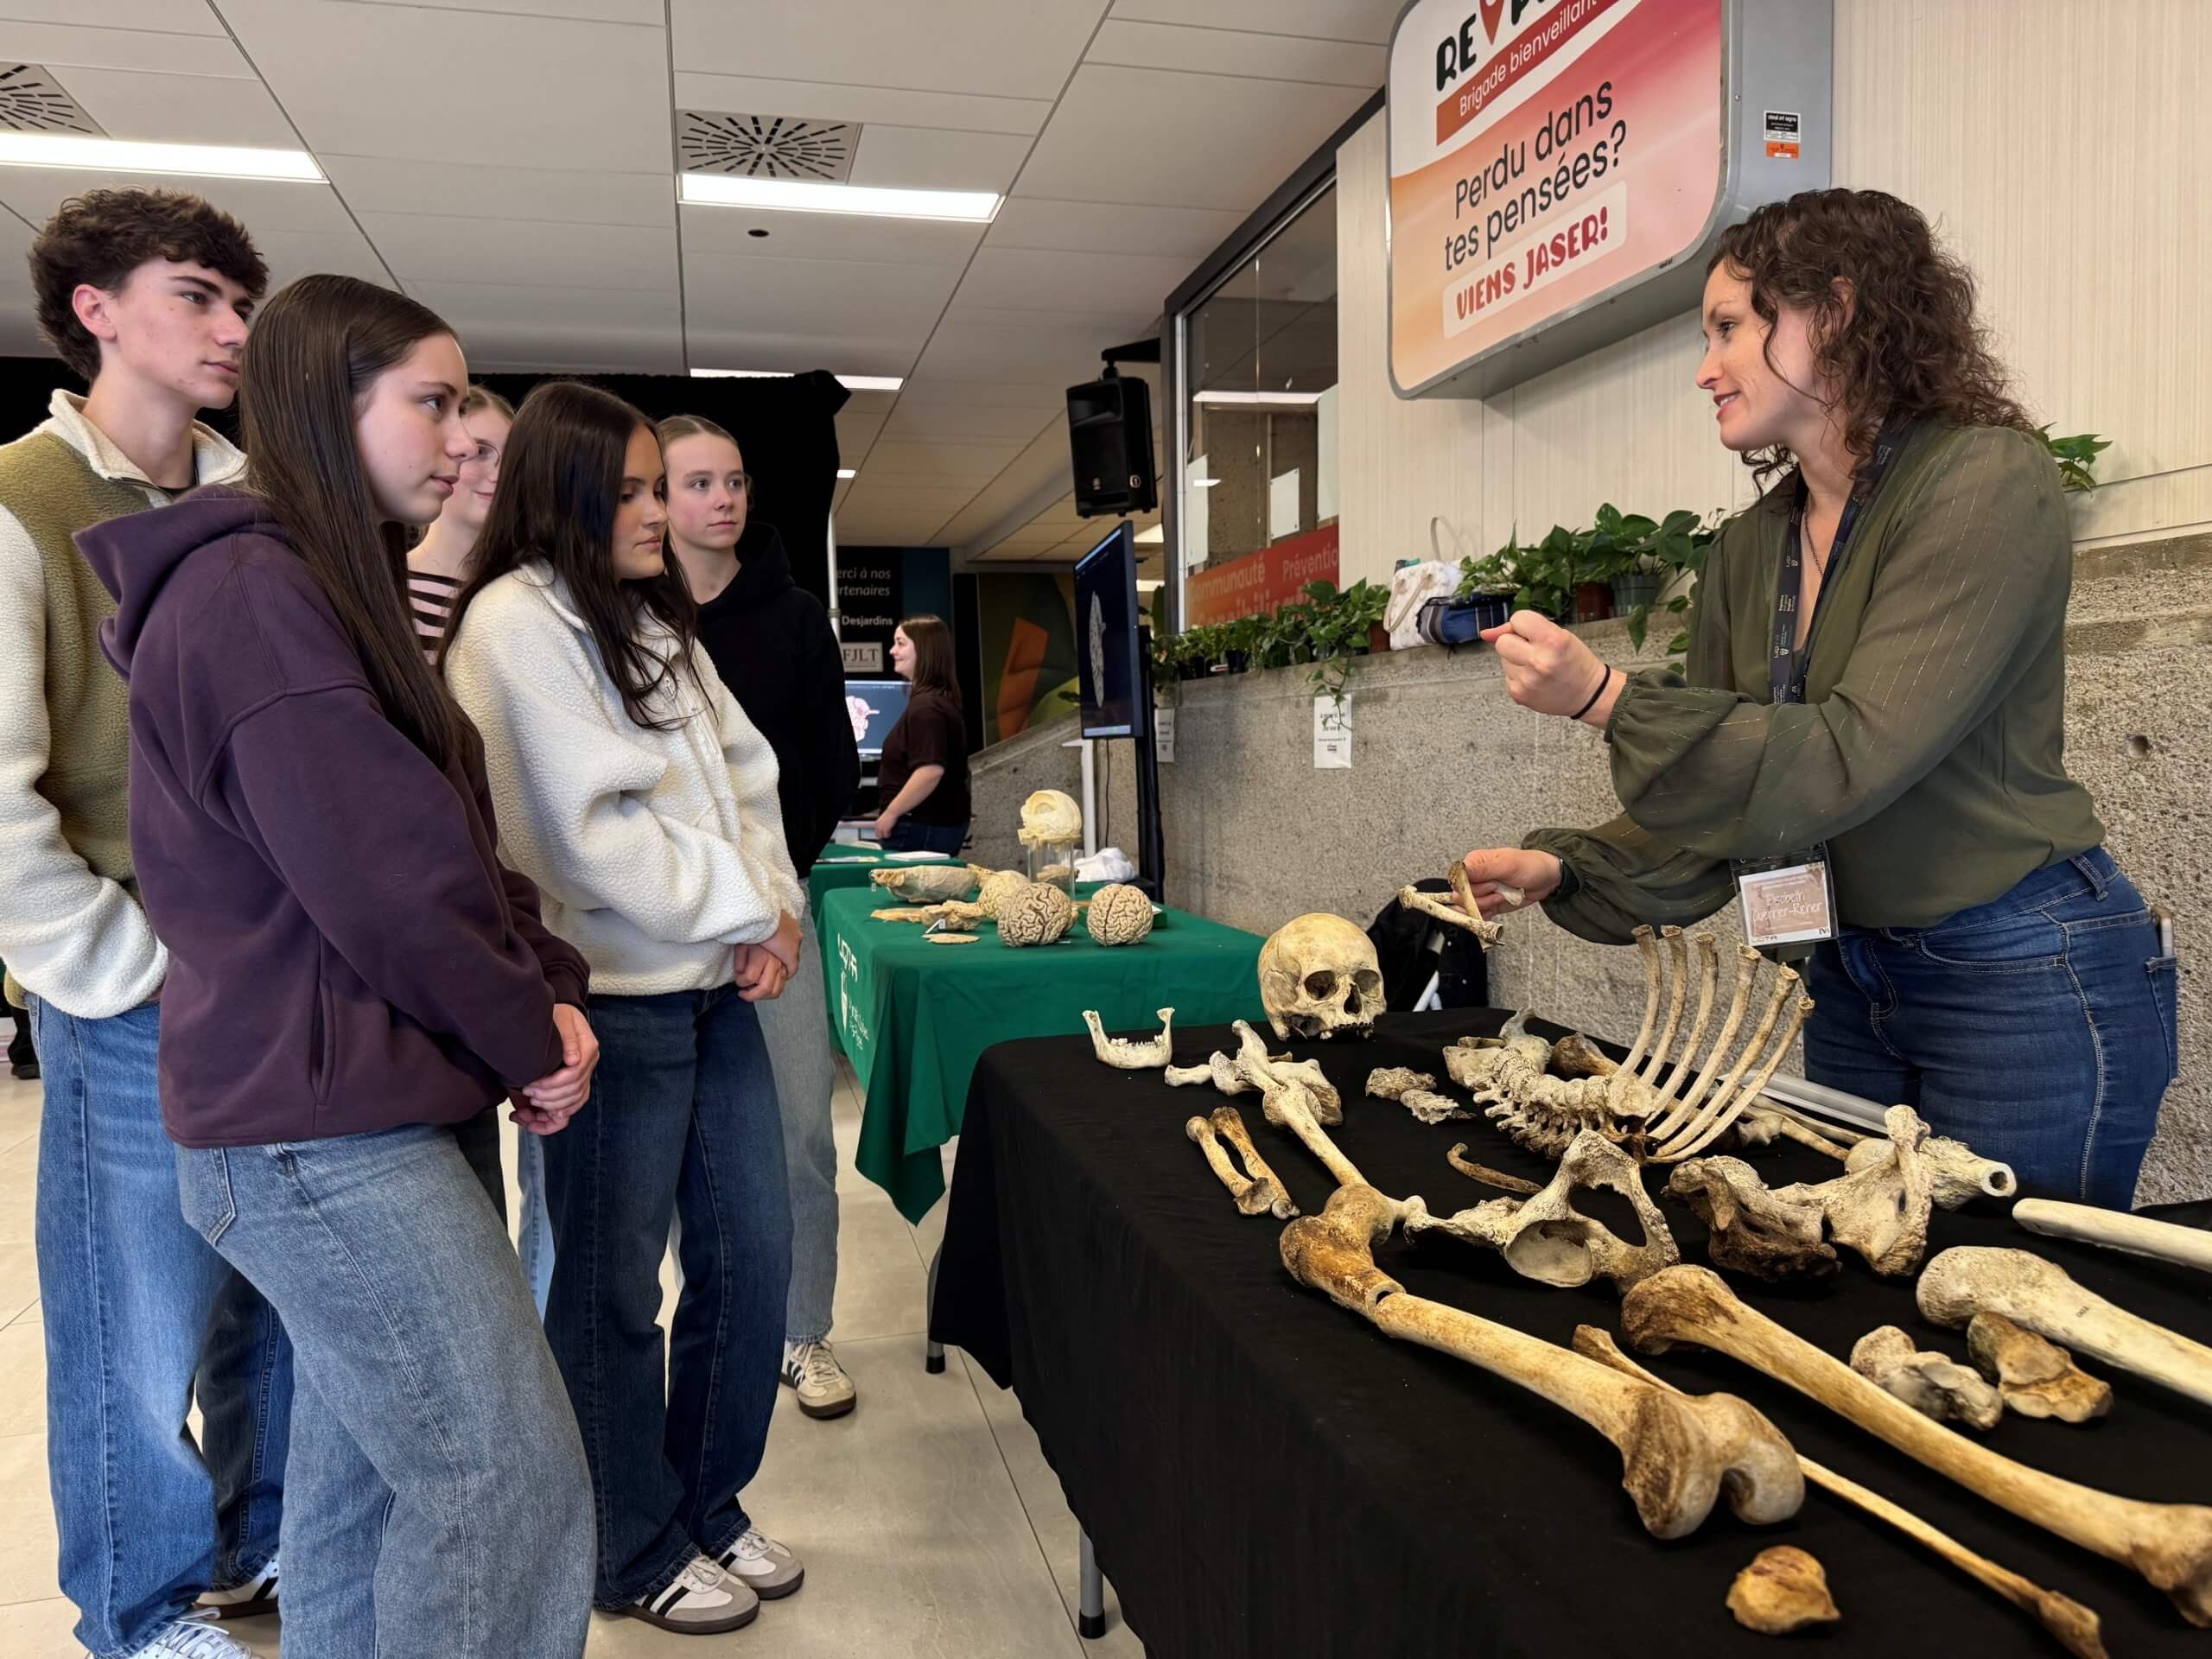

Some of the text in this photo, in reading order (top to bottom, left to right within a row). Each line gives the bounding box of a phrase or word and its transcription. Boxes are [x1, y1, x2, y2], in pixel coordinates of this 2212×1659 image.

[1459, 0, 1597, 117] Brigade bienveillan
[1456, 81, 1612, 219] Perdu dans
[1445, 119, 1626, 270] tes pensées?
[1456, 206, 1608, 320] VIENS JASER!
[836, 567, 857, 580] erci
[870, 569, 891, 580] nos
[837, 584, 890, 596] rtenaires
[1282, 542, 1339, 581] Préventio
[842, 615, 893, 626] Desjardins
